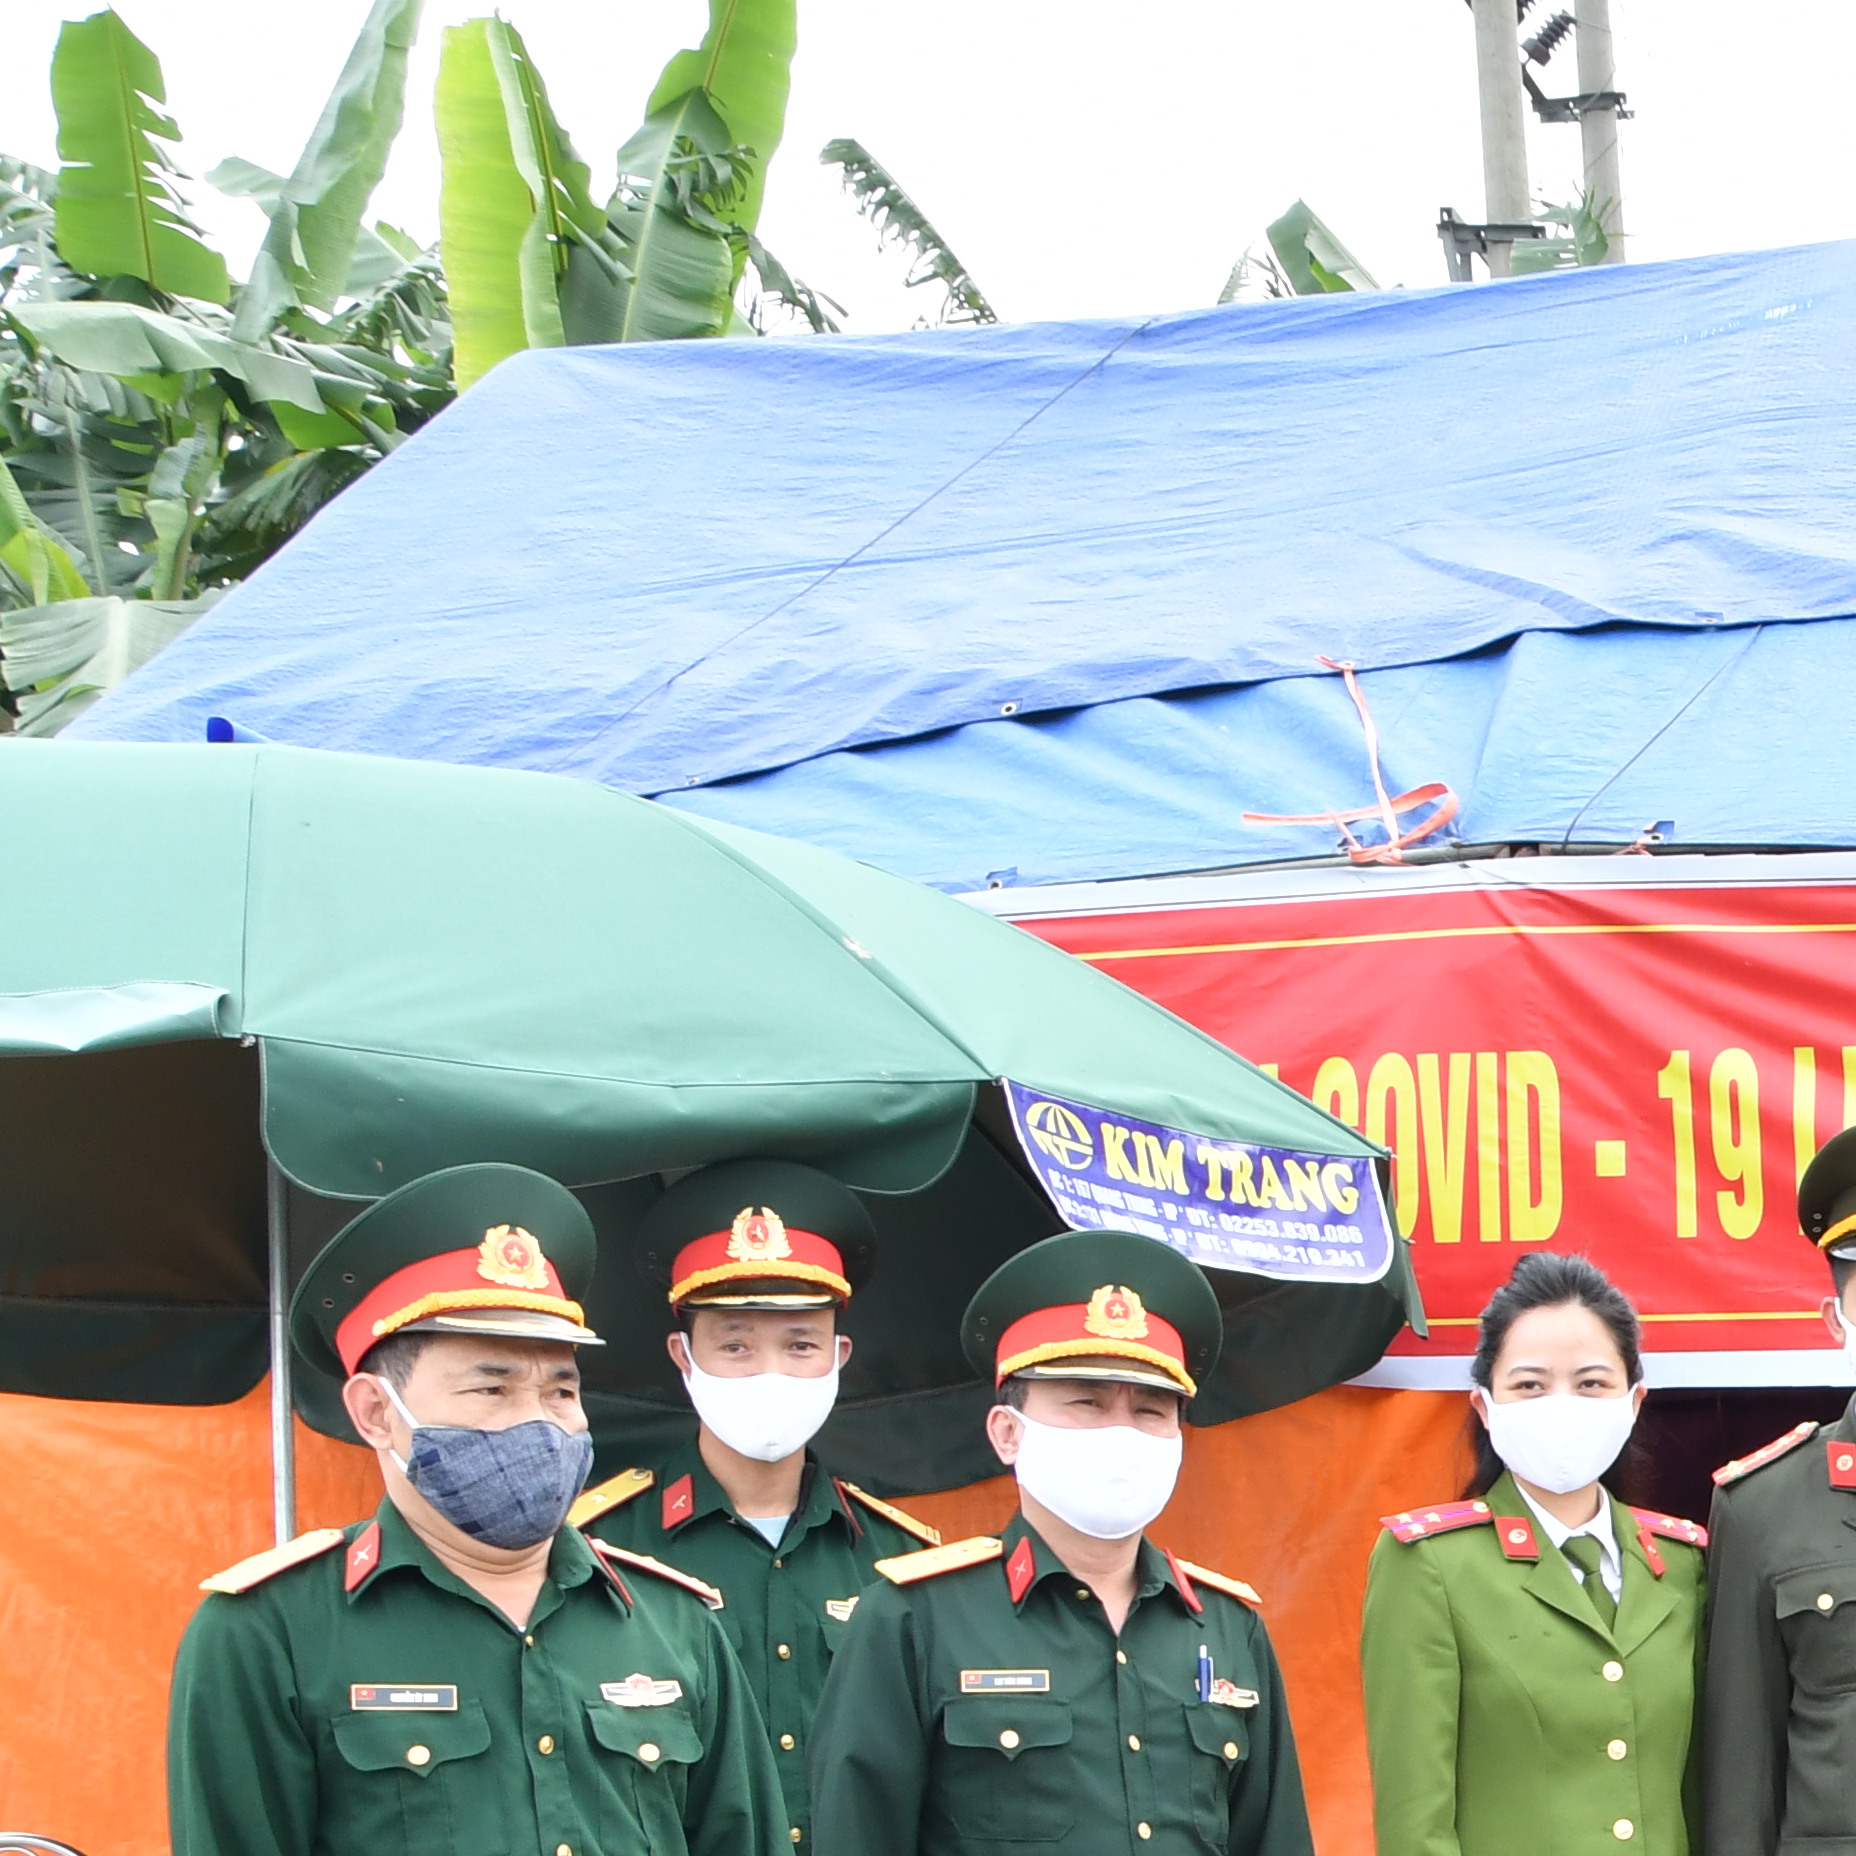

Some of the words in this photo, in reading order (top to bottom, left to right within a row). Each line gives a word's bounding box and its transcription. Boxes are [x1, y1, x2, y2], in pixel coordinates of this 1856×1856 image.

[1099, 1121, 1190, 1197] KIM
[1196, 1145, 1360, 1216] TRANG
[1594, 1141, 1626, 1177] -
[1657, 1047, 1765, 1241] 19
